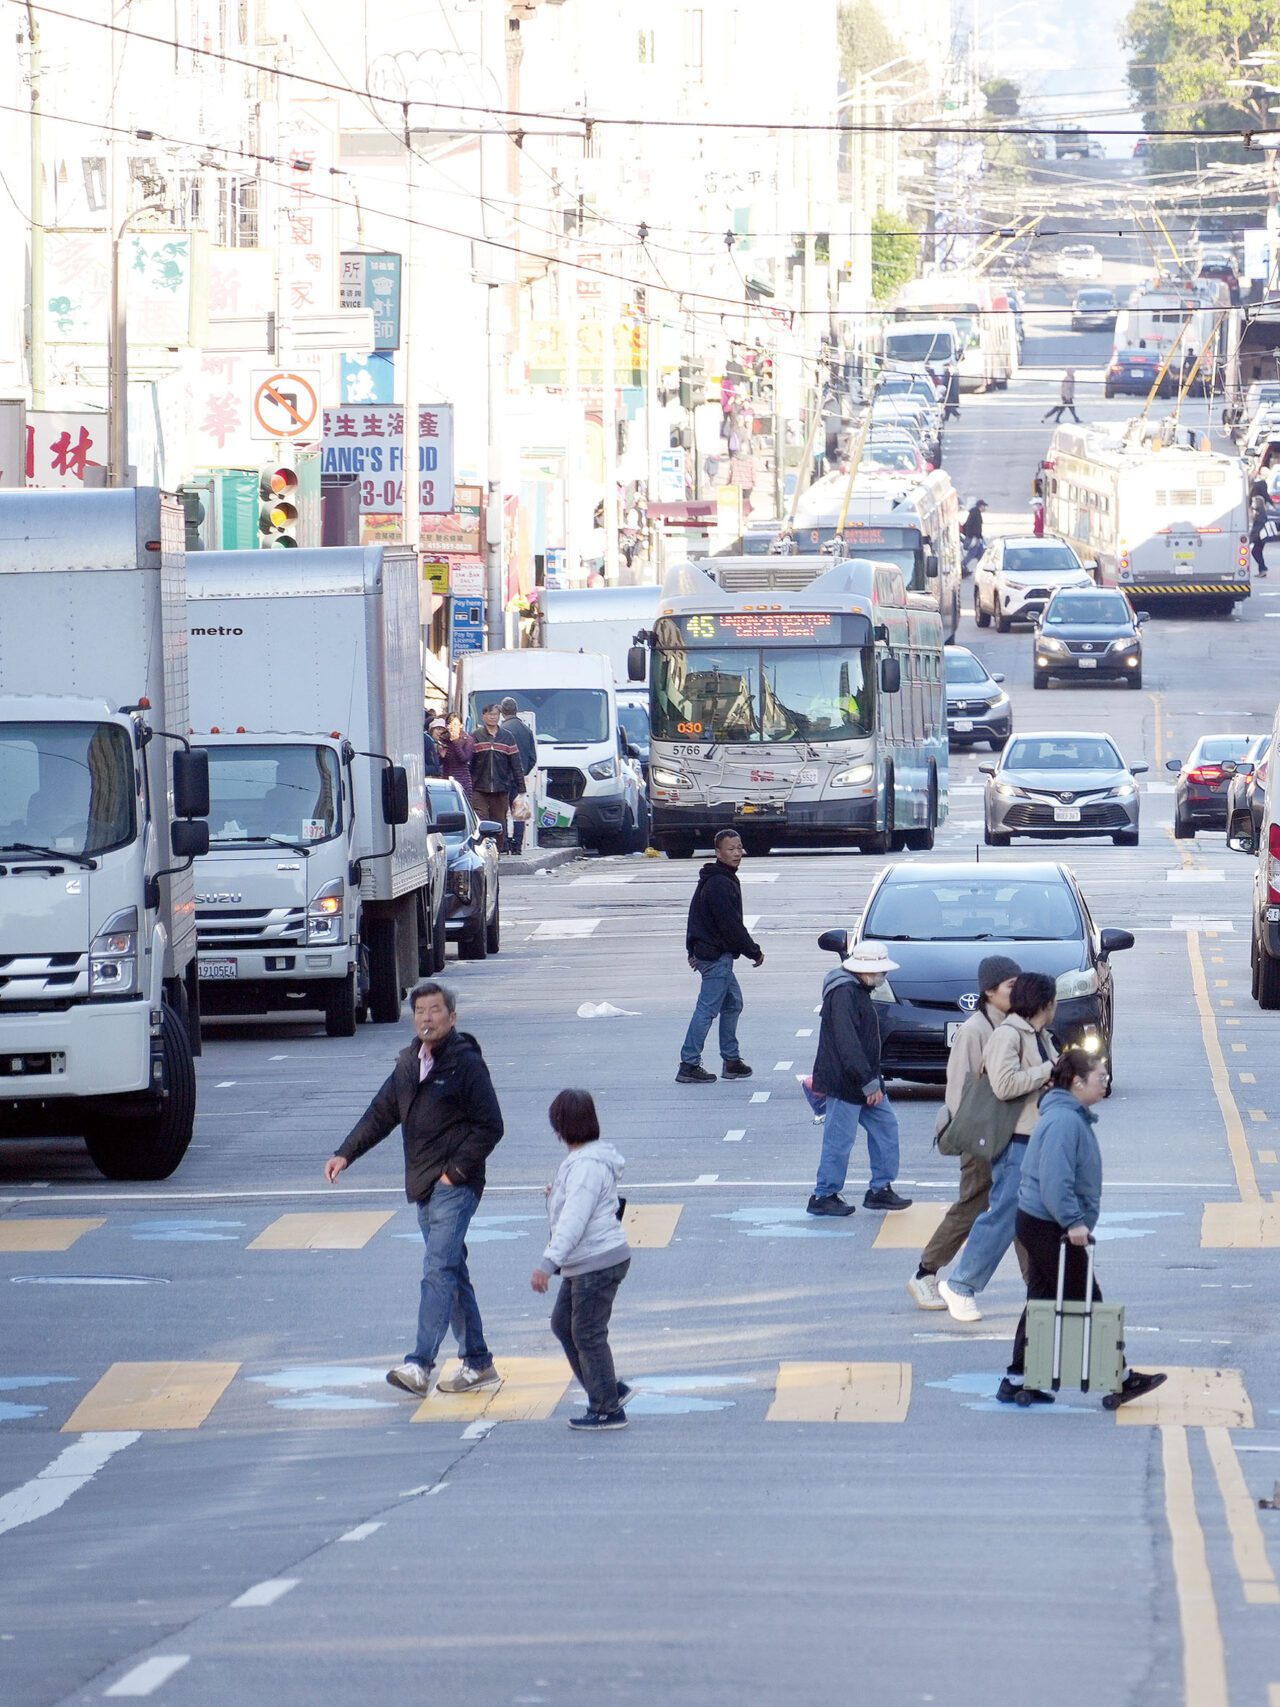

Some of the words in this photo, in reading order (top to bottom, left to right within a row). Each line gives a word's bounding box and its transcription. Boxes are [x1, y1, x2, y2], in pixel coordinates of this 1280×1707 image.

[454, 600, 466, 608] Pay
[191, 626, 243, 636] metro
[687, 615, 715, 637] 45
[677, 722, 702, 733] 030
[673, 745, 700, 756] 5766
